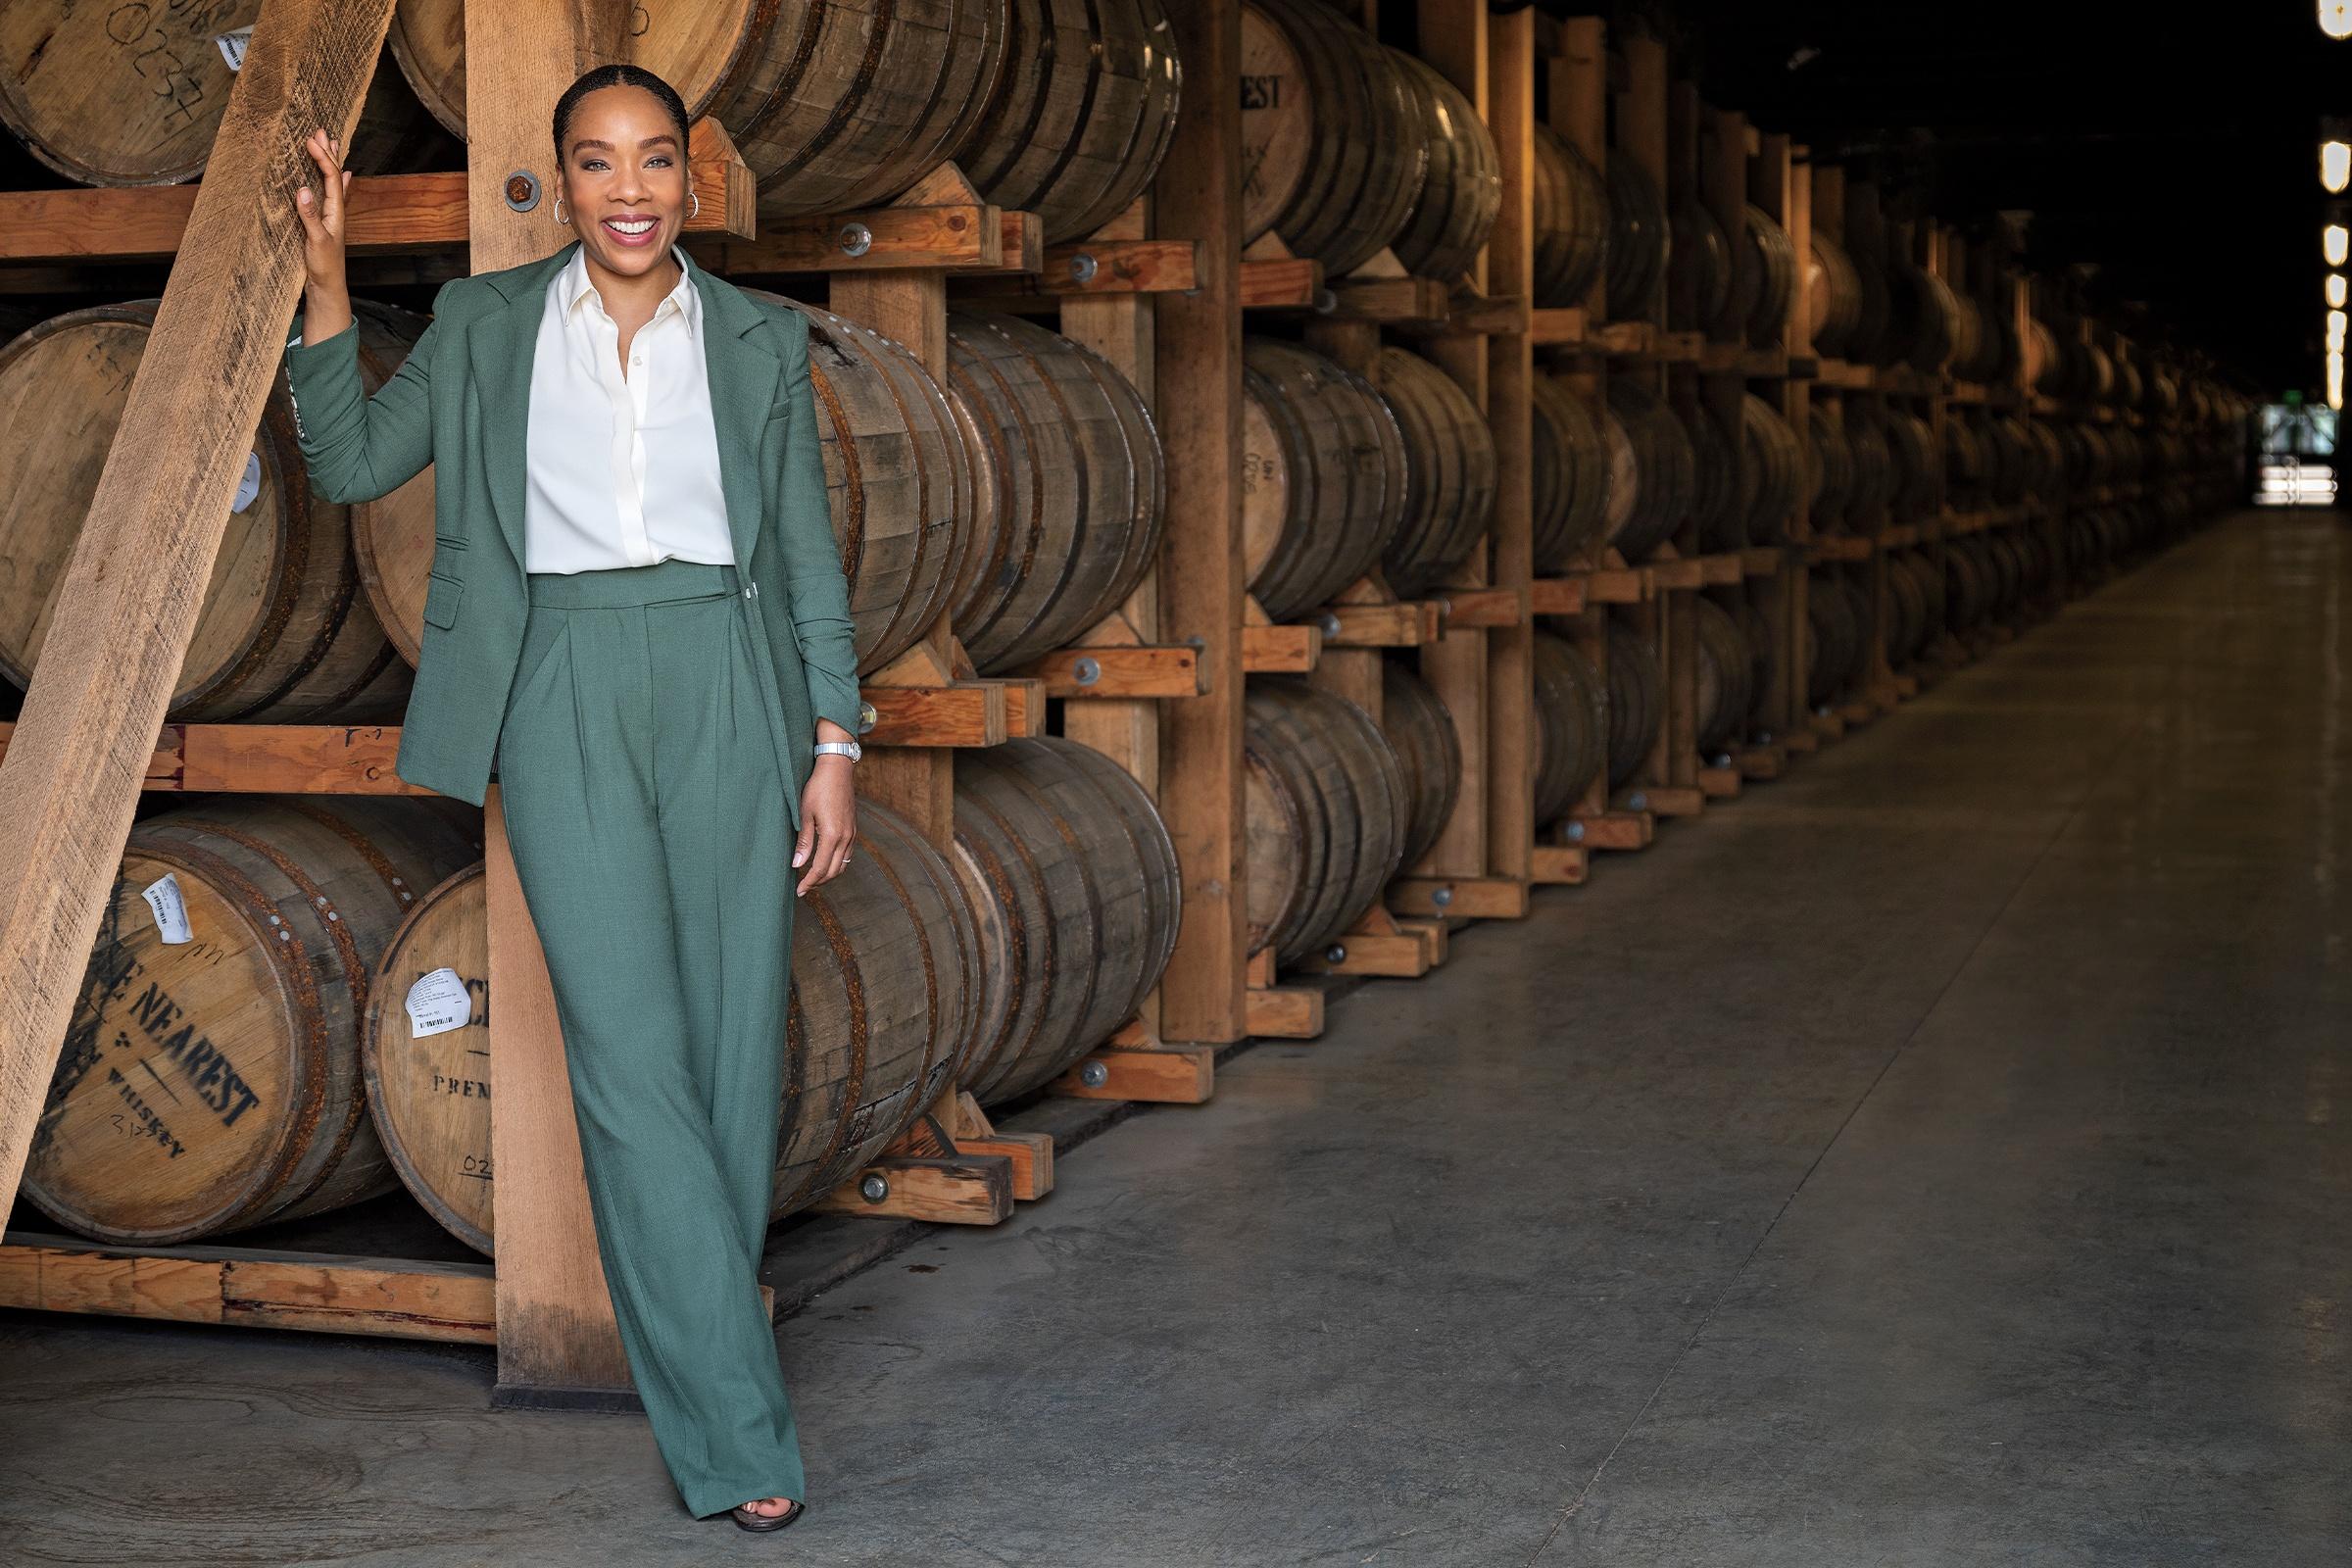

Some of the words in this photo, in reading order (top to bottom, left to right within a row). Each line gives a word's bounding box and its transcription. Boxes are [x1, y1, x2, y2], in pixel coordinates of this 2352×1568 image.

[105, 3, 204, 122] 0237
[128, 981, 260, 1127] NEAREST
[109, 1066, 186, 1159] WHISKEY
[463, 1154, 494, 1175] 02
